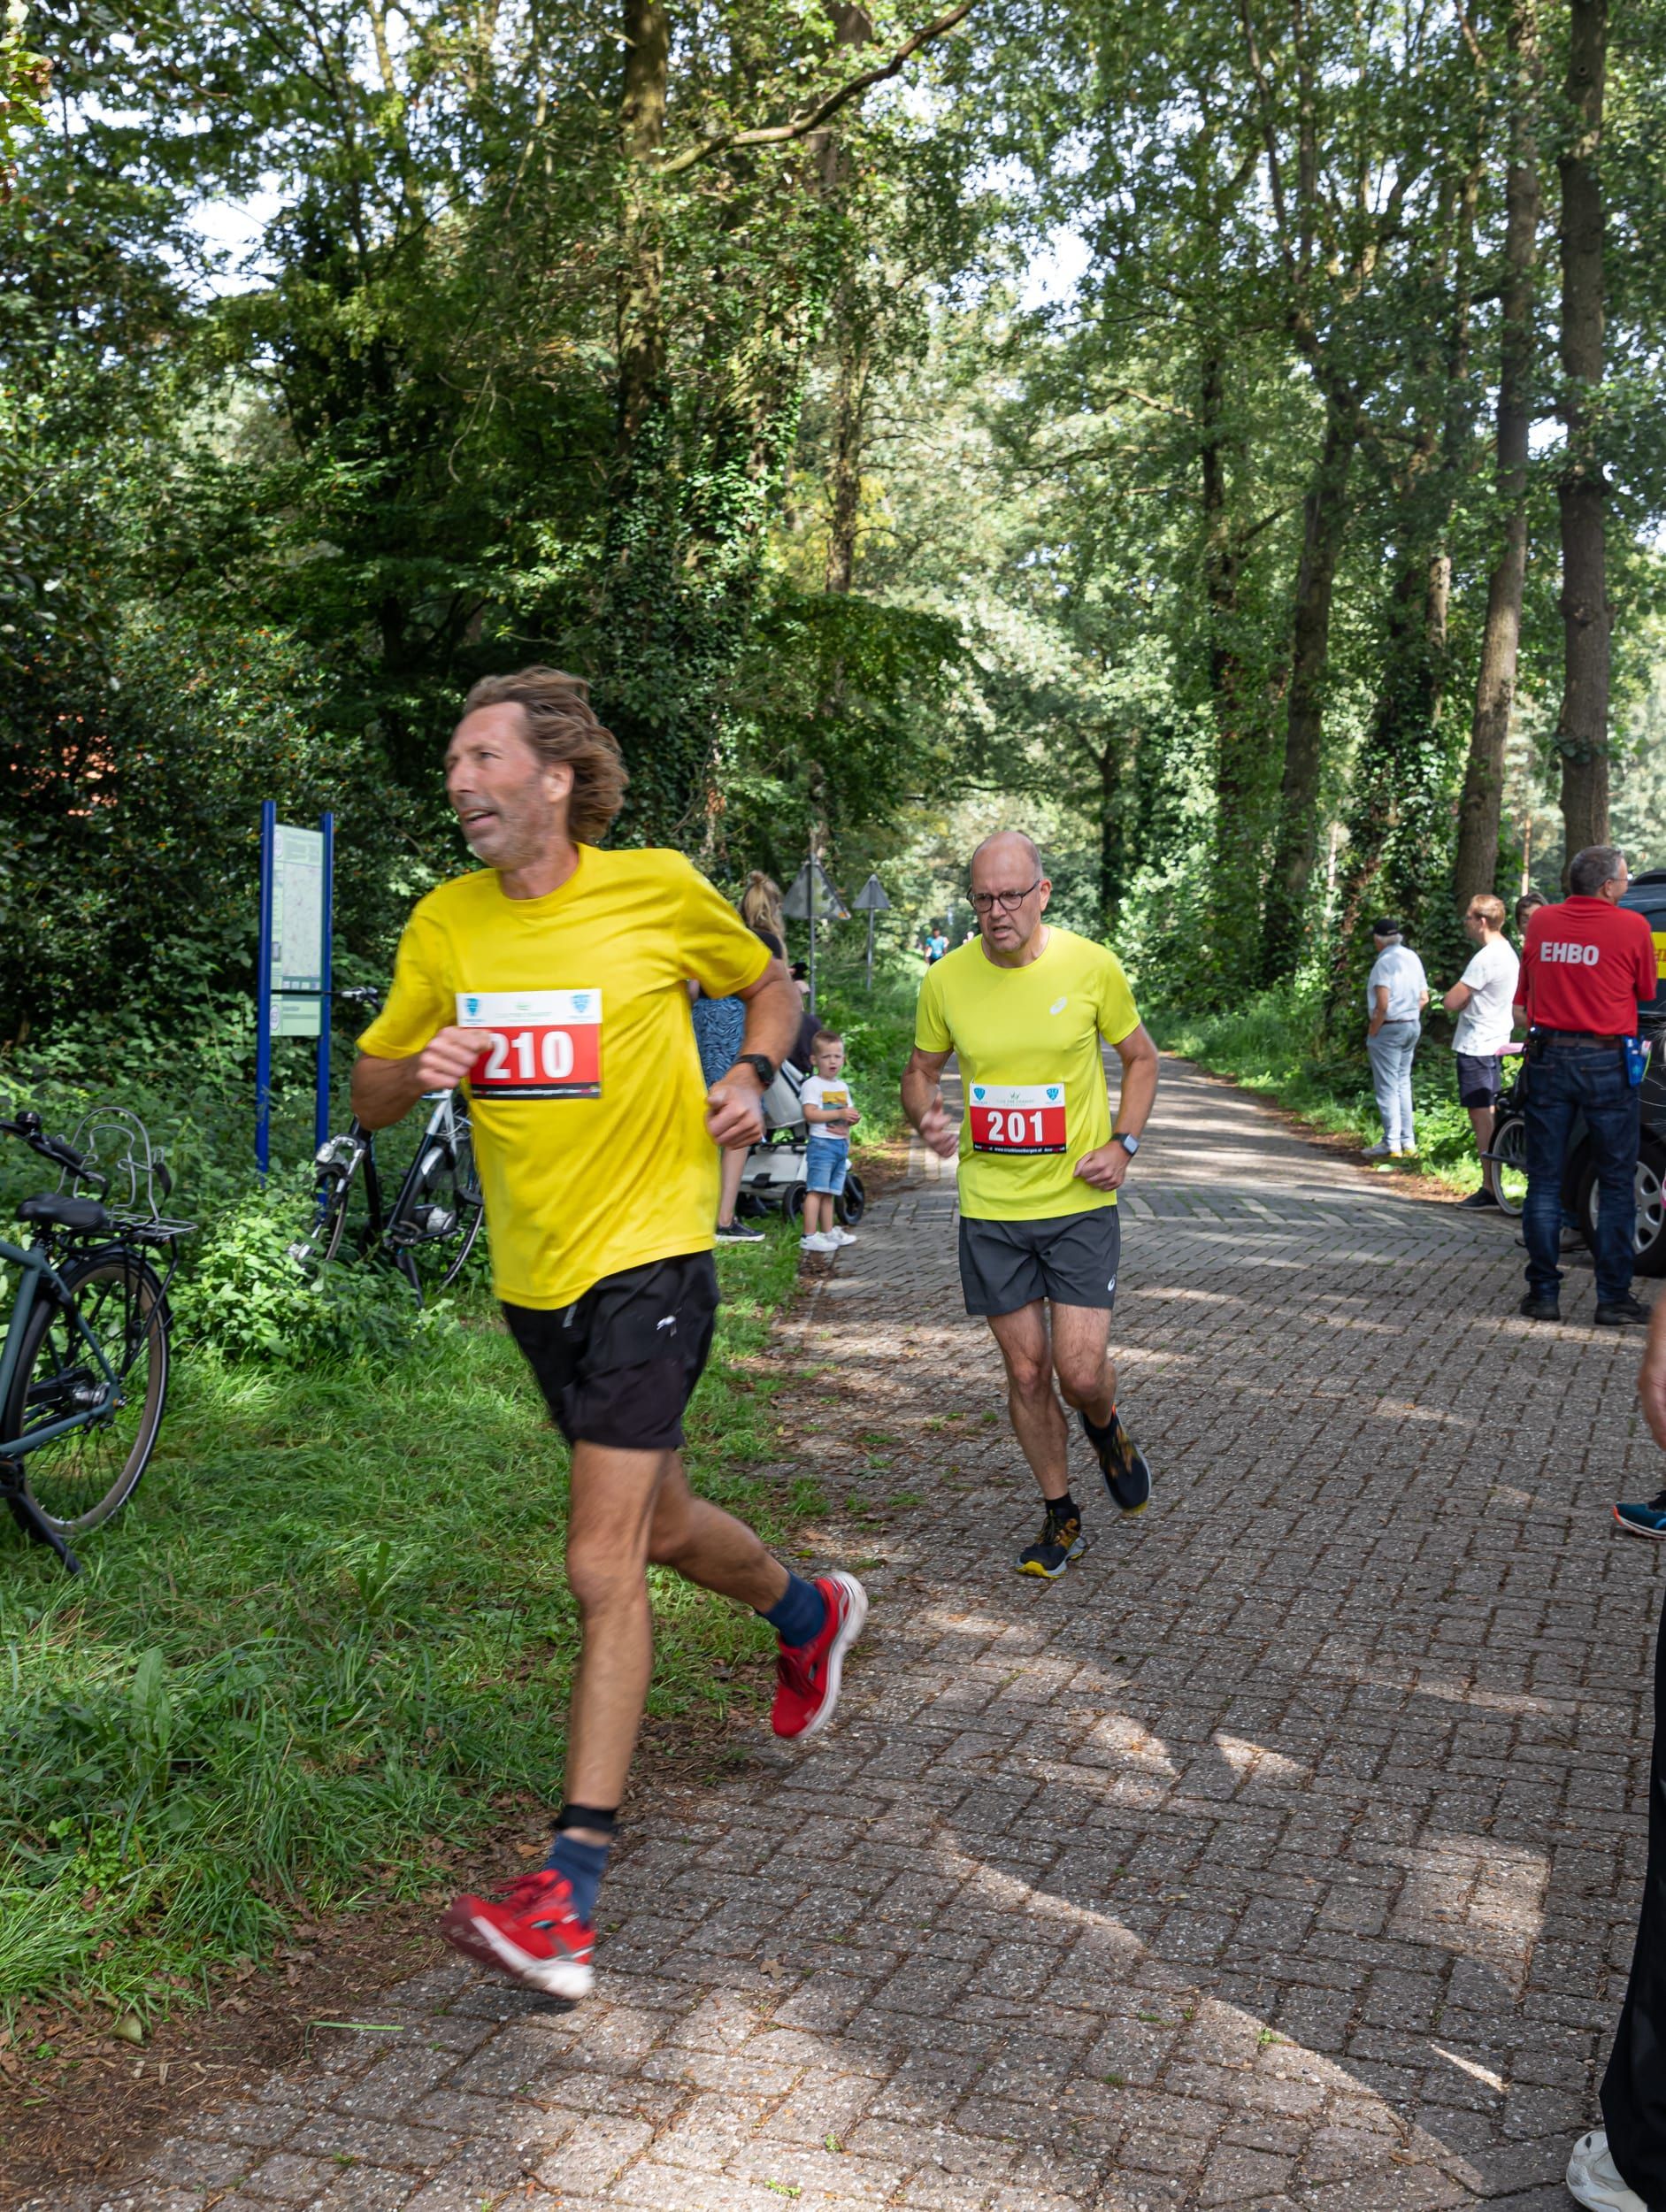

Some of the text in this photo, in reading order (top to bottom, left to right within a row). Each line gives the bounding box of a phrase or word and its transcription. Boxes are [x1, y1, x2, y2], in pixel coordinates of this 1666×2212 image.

[1540, 941, 1600, 966] EHBO
[484, 1031, 574, 1079] 210
[987, 1111, 1043, 1143] 201
